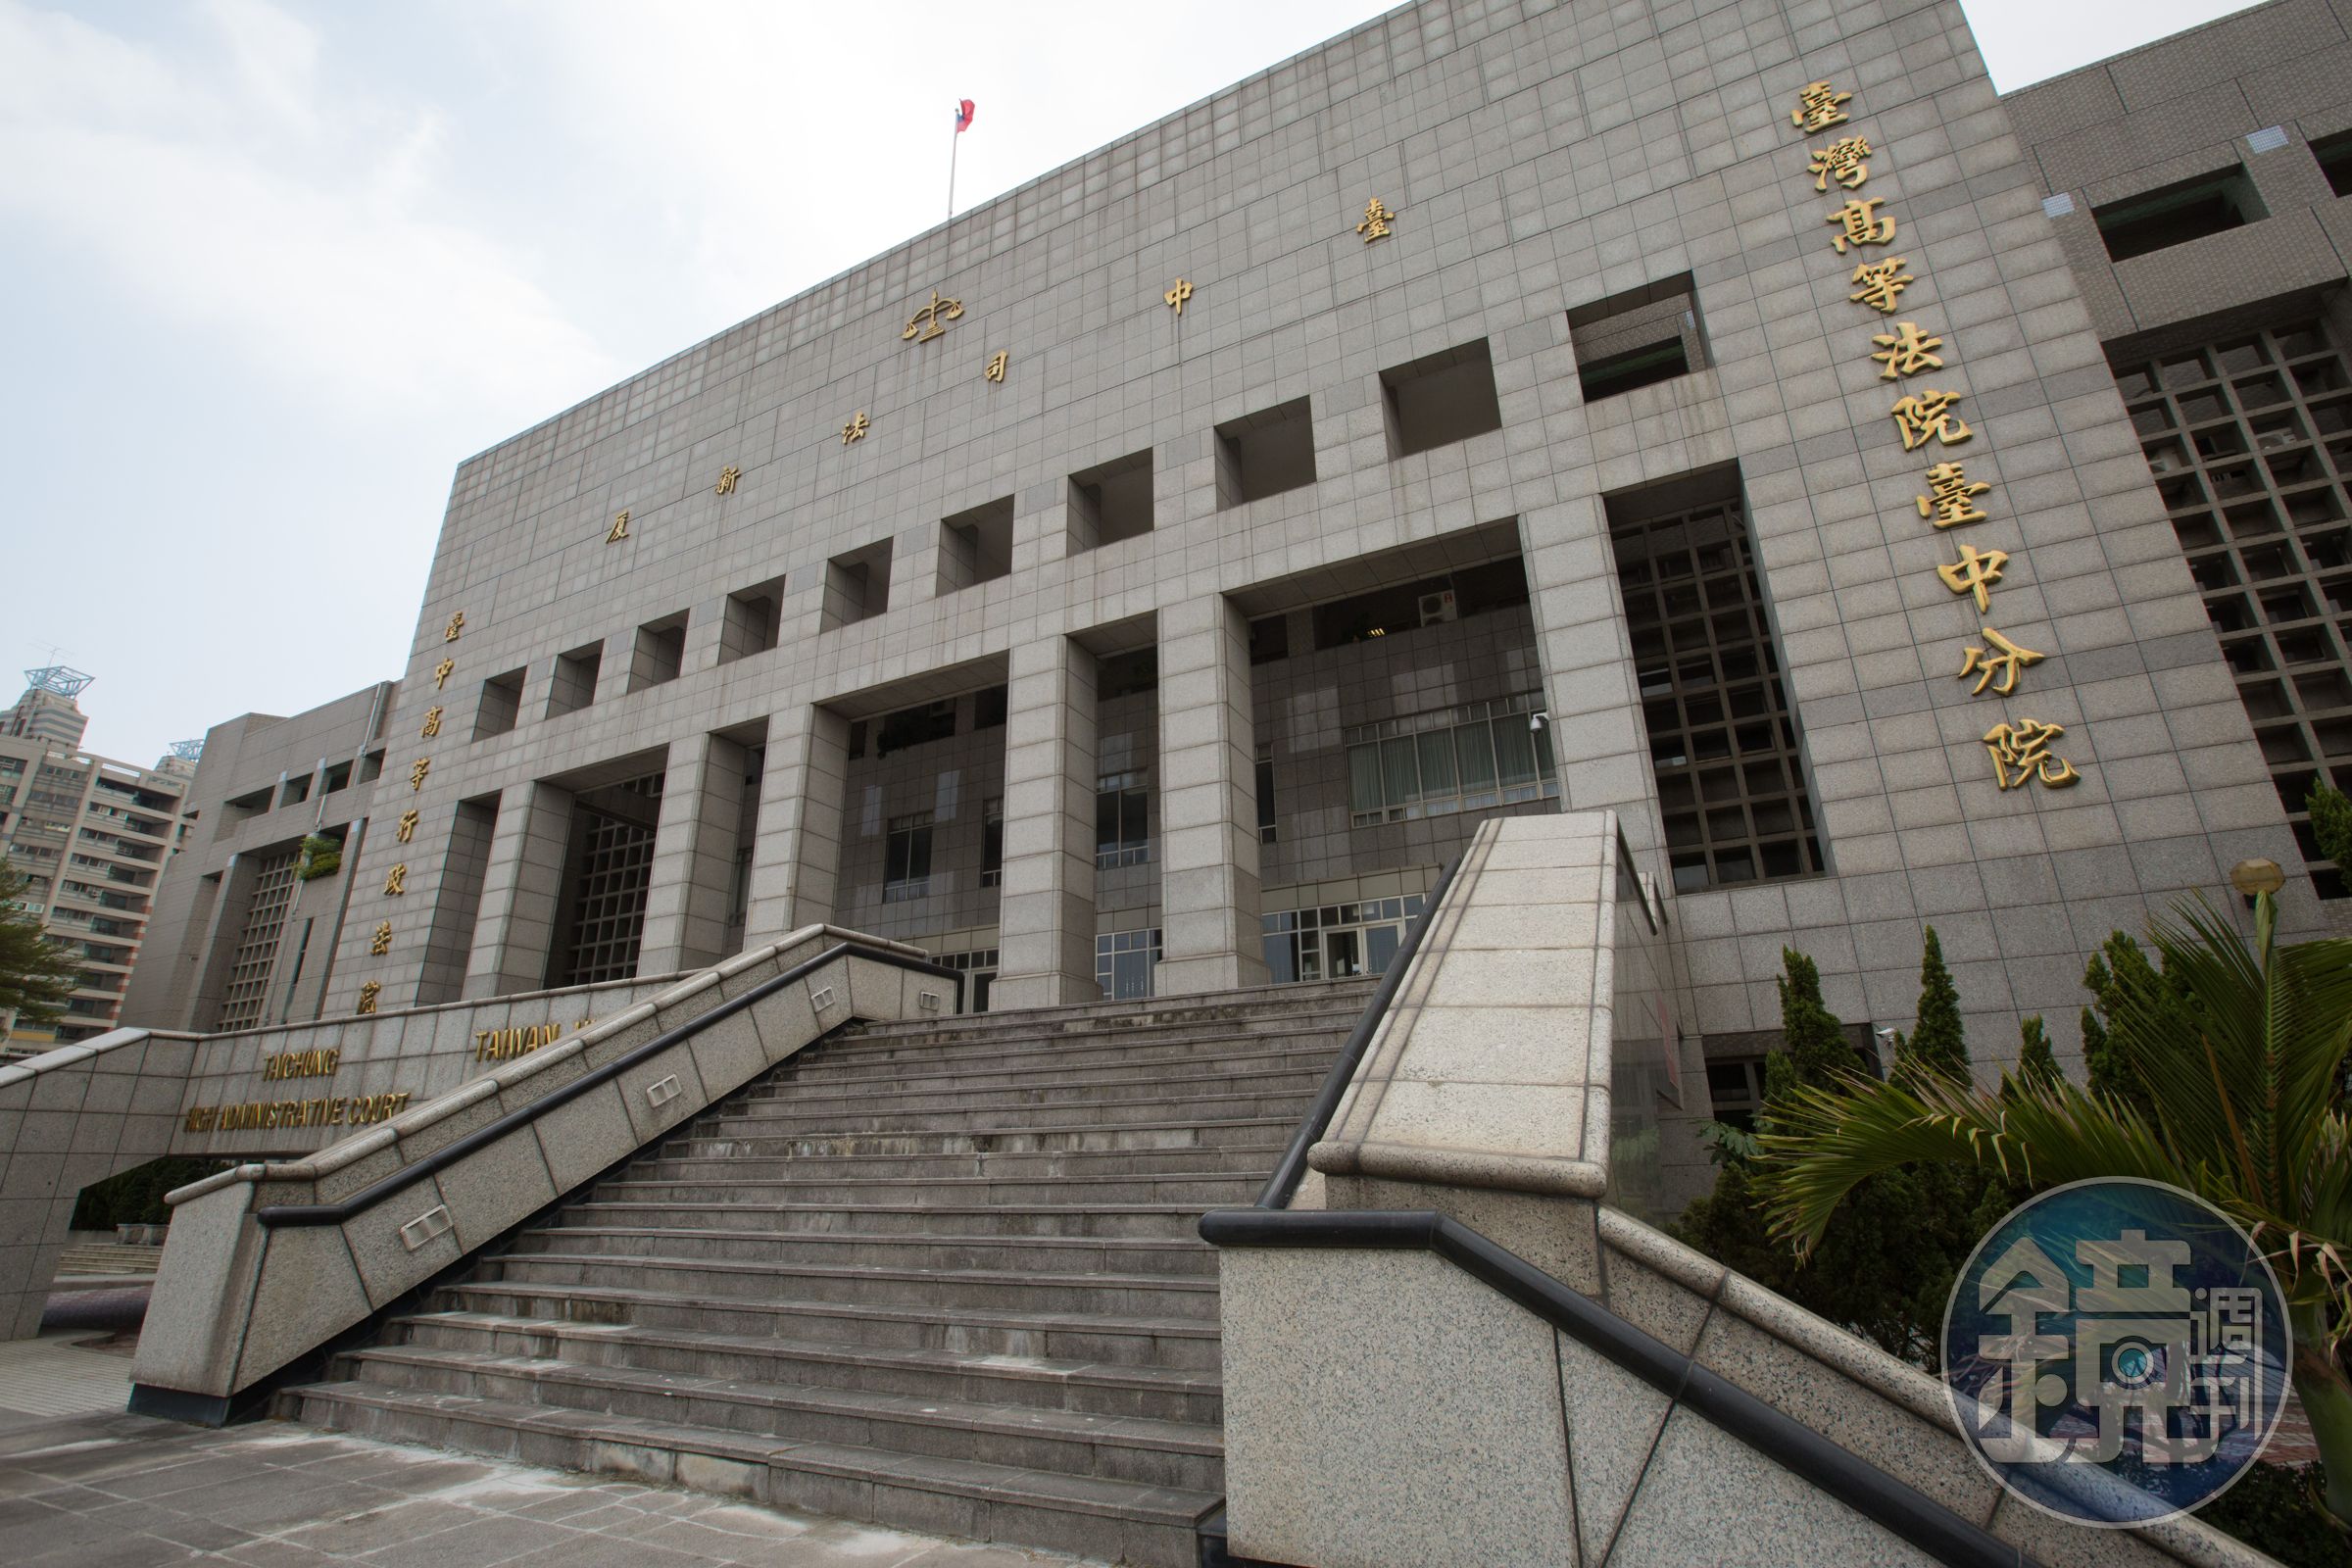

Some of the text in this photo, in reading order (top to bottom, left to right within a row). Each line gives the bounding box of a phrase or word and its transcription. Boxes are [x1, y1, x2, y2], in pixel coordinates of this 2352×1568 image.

[475, 1023, 562, 1062] TAIWAN
[263, 1049, 340, 1082] TAICHUNG
[183, 1092, 412, 1133] HIGH ADMINISTRATIVE COURT
